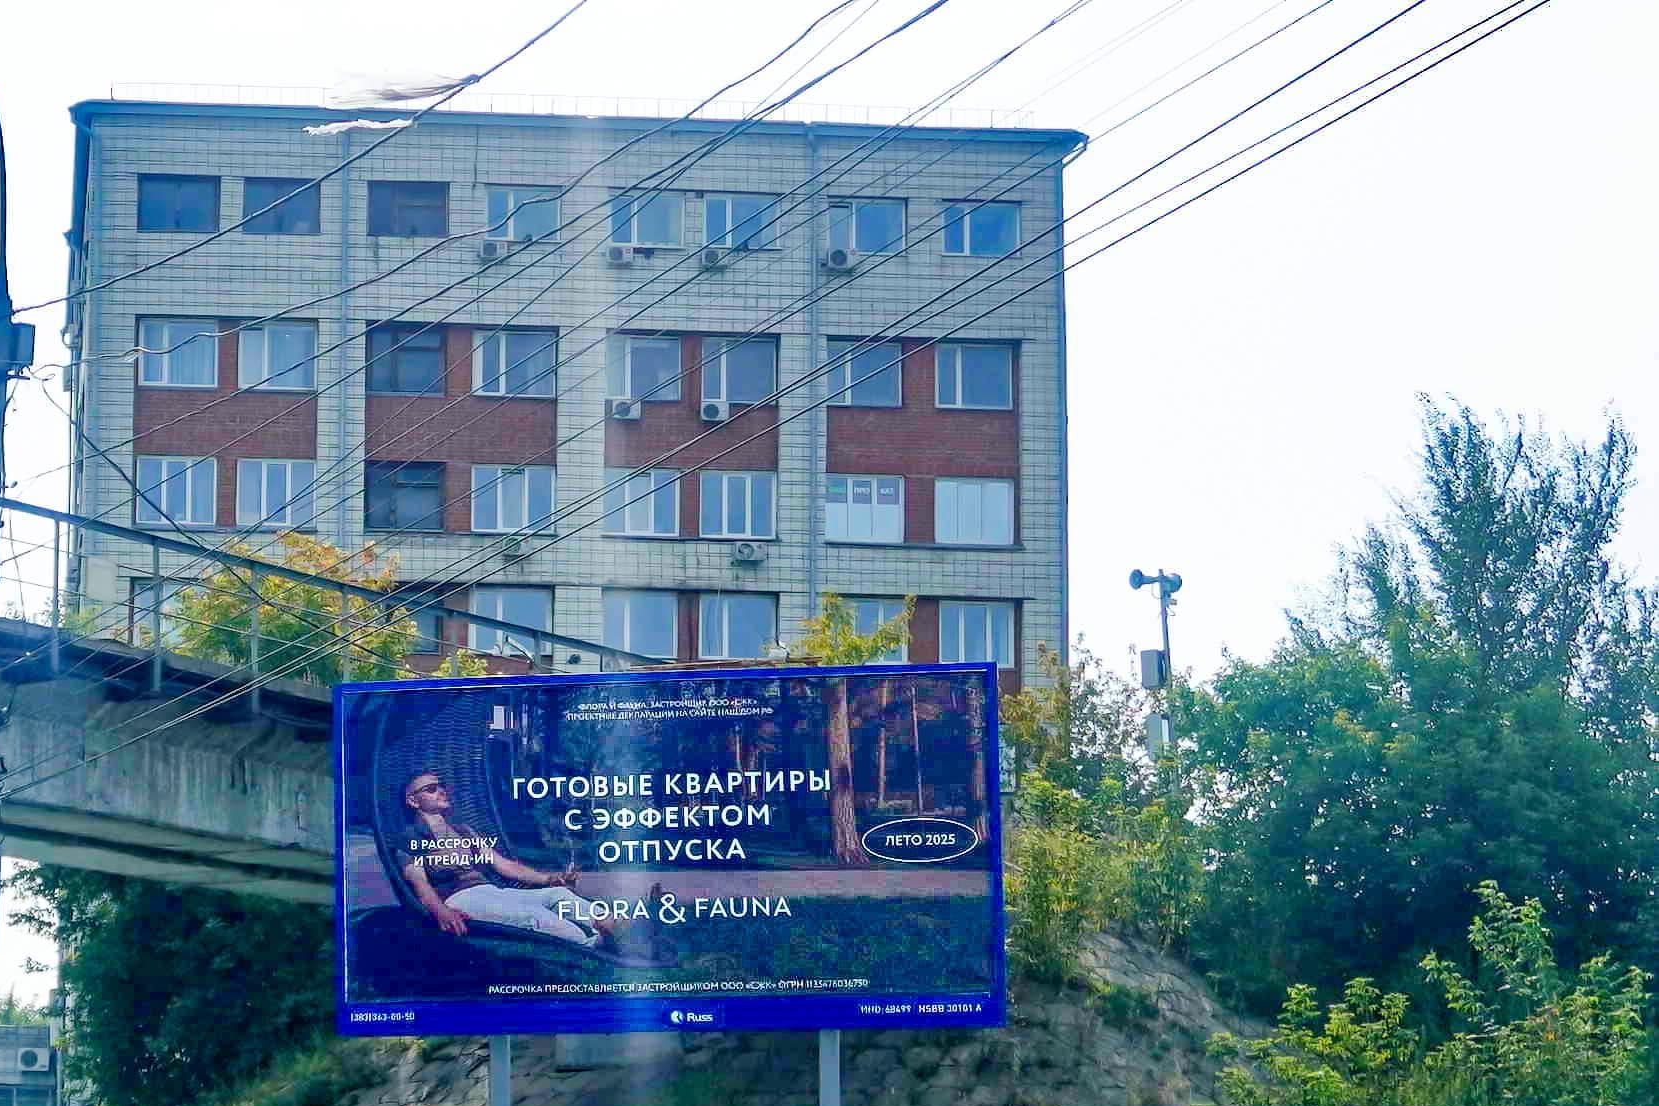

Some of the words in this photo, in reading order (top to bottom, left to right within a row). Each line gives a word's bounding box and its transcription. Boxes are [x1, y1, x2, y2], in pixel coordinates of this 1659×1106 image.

[512, 774, 654, 800] ГОТОВЫЕ
[664, 769, 832, 796] КВАРТИРЫ
[564, 809, 583, 831] С
[591, 804, 770, 831] ЭФФЕКТОМ
[410, 839, 418, 850] В
[421, 837, 498, 850] РАССРОЧКУ
[885, 834, 923, 846] ЛЕТО
[925, 833, 956, 846] 2025
[598, 838, 747, 863] ОТПУСКА
[414, 855, 424, 867] И
[426, 852, 494, 866] ТРЕЙД-ИН
[557, 898, 650, 922] FLORA
[657, 893, 687, 924] &
[694, 896, 792, 919] FAUNA
[488, 984, 542, 994] РАССРОЧКА
[720, 981, 744, 991] ООО
[686, 1012, 714, 1023] Russ
